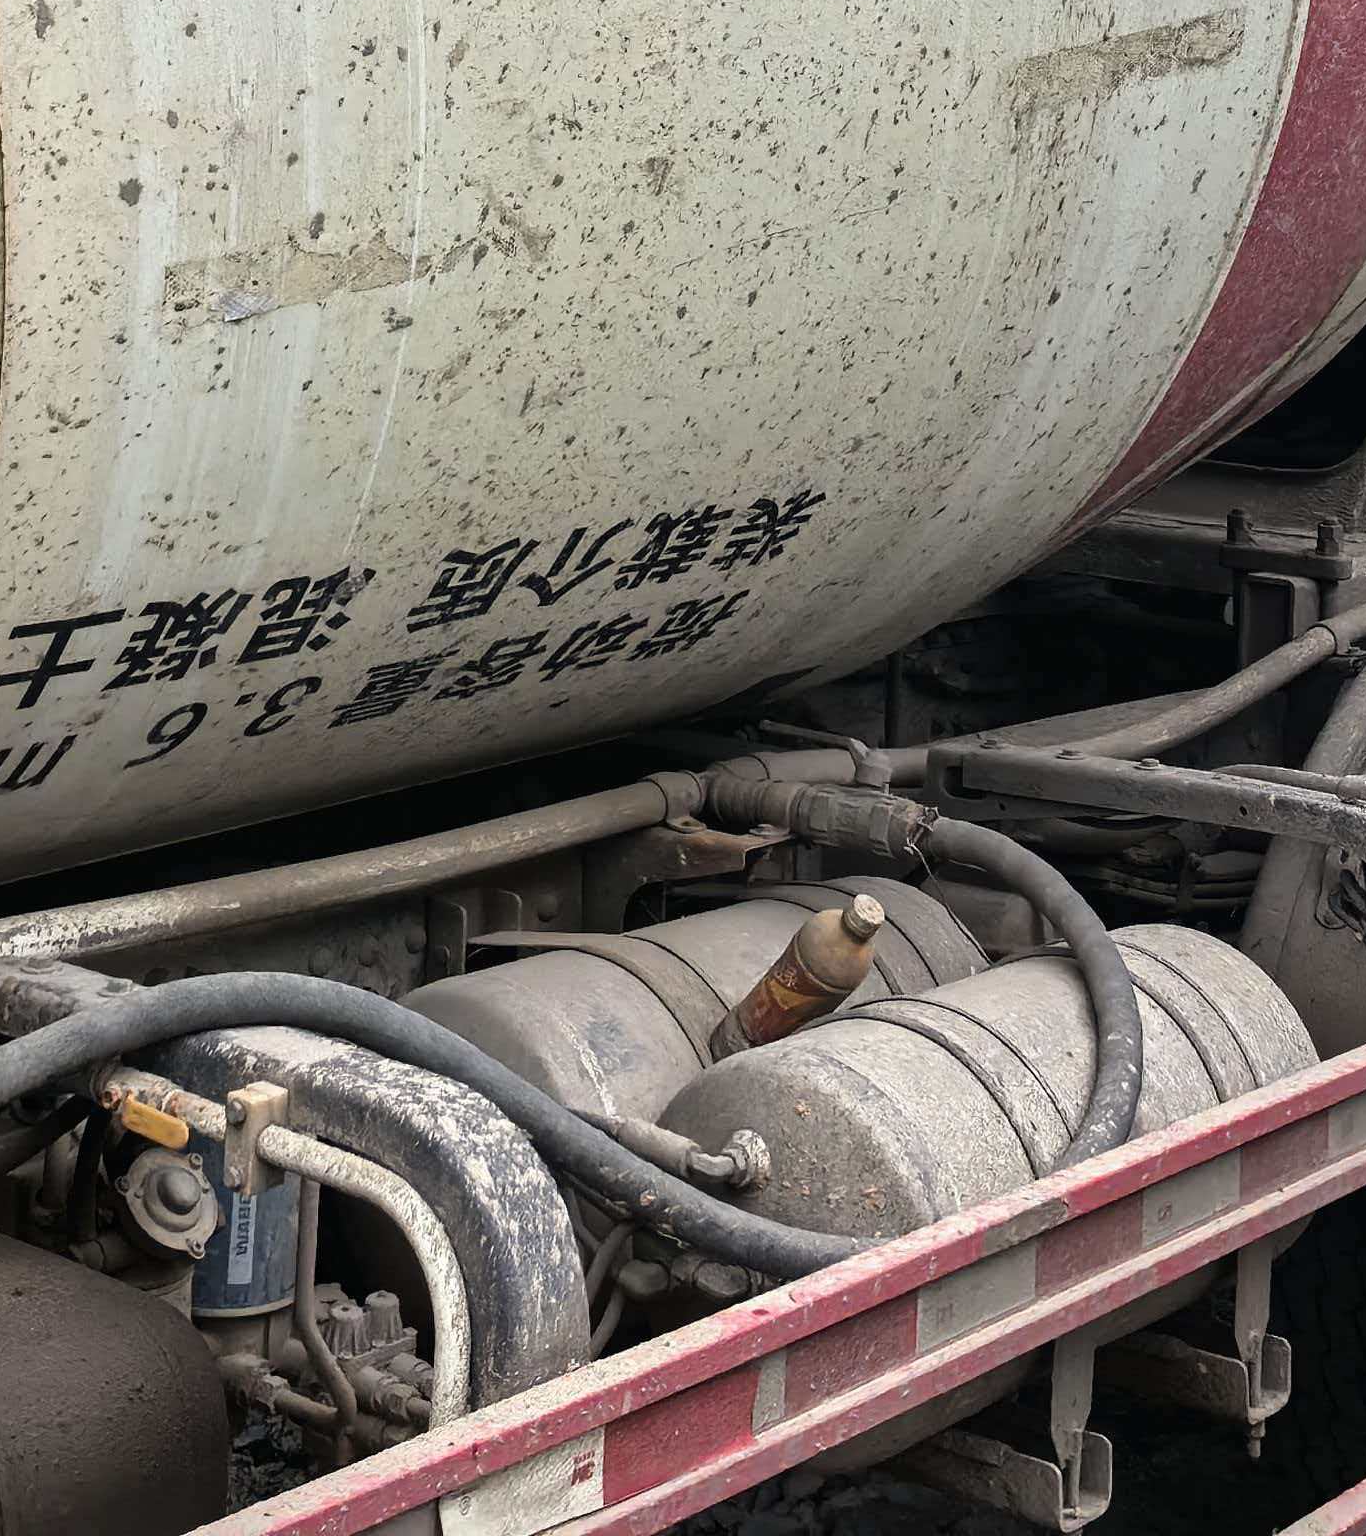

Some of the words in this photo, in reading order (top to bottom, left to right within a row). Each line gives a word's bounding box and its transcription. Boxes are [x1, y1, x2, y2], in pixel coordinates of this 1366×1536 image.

[401, 488, 827, 635] 装载介质
[123, 674, 323, 770] 3.6
[327, 588, 751, 730] 搅动容量
